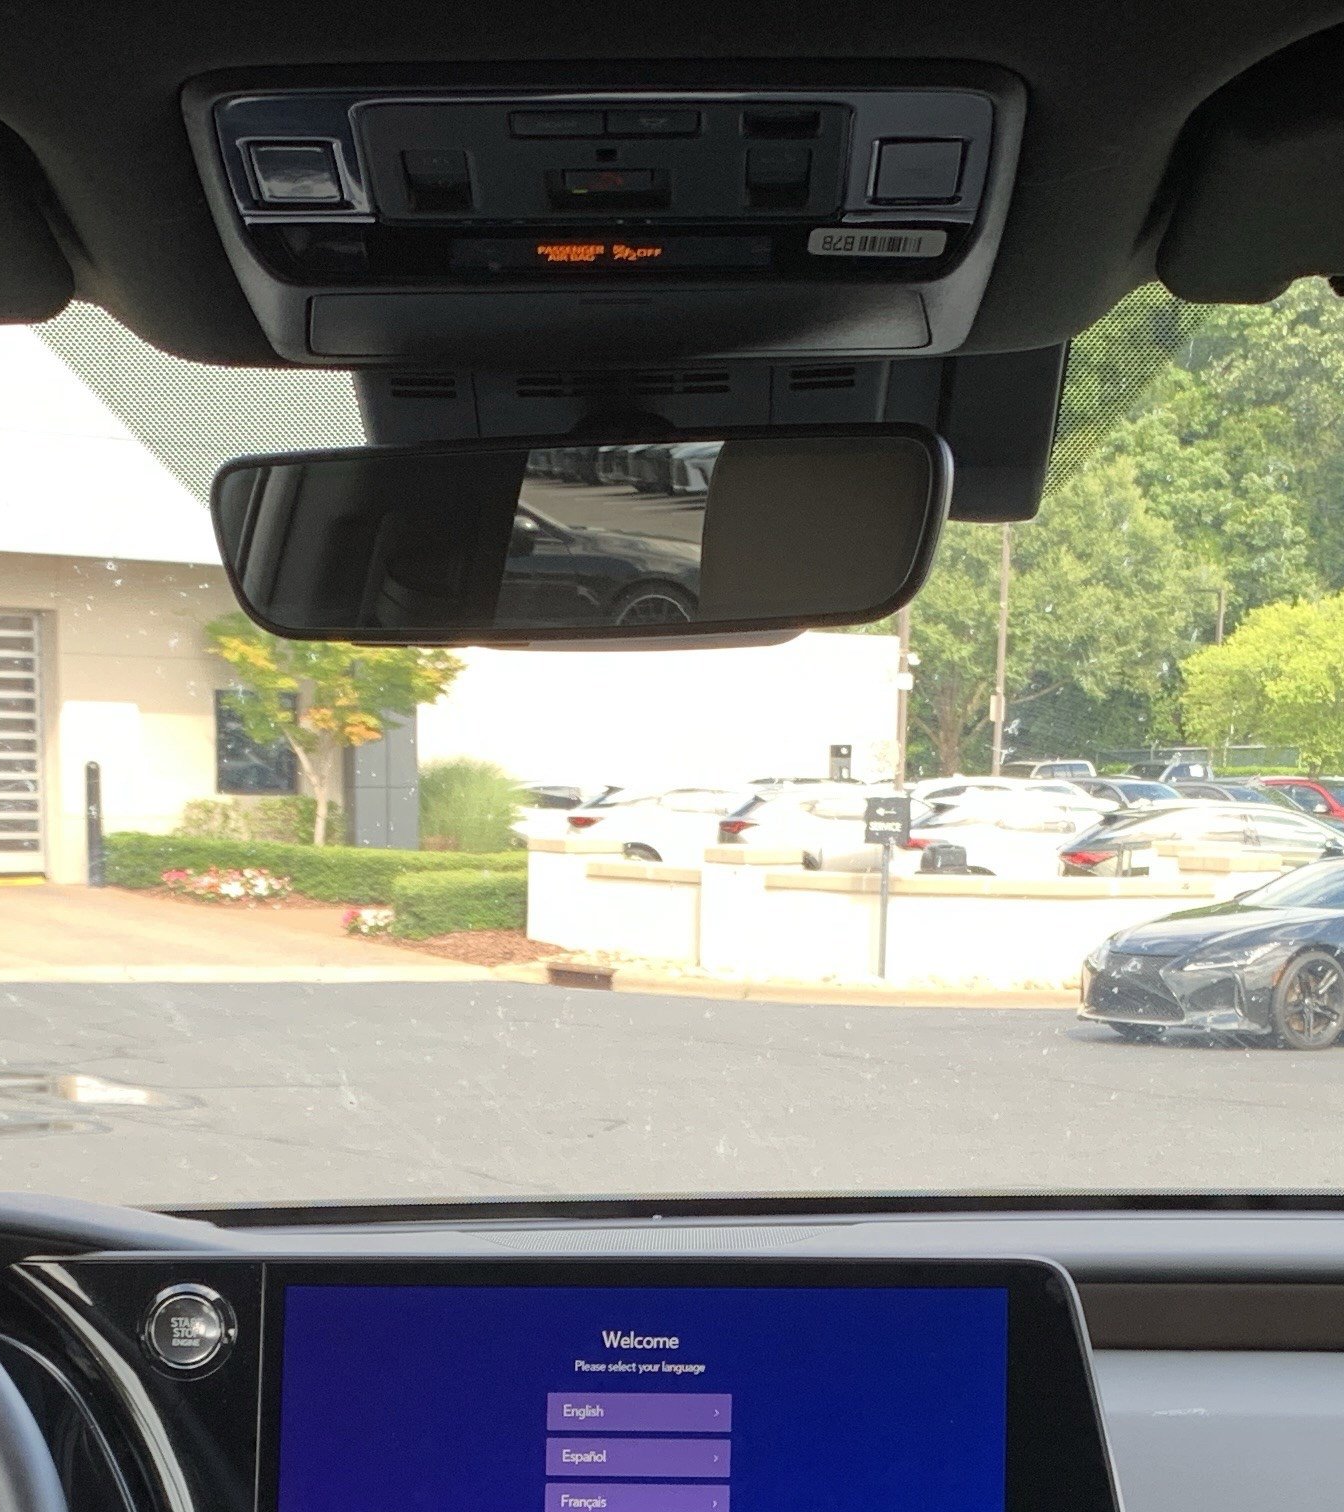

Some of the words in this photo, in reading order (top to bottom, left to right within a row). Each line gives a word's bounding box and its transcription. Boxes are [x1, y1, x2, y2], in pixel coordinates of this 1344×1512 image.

[537, 244, 605, 254] PASSENGER
[636, 248, 663, 257] OFF
[868, 820, 903, 832] SERVICE
[172, 1327, 200, 1338] STOP
[601, 1329, 680, 1350] Welcome
[574, 1359, 607, 1373] Please
[607, 1360, 637, 1373] select
[637, 1363, 661, 1375] your
[661, 1360, 707, 1376] language
[562, 1403, 605, 1420] English
[561, 1448, 607, 1465] Español
[560, 1493, 608, 1512] Français
